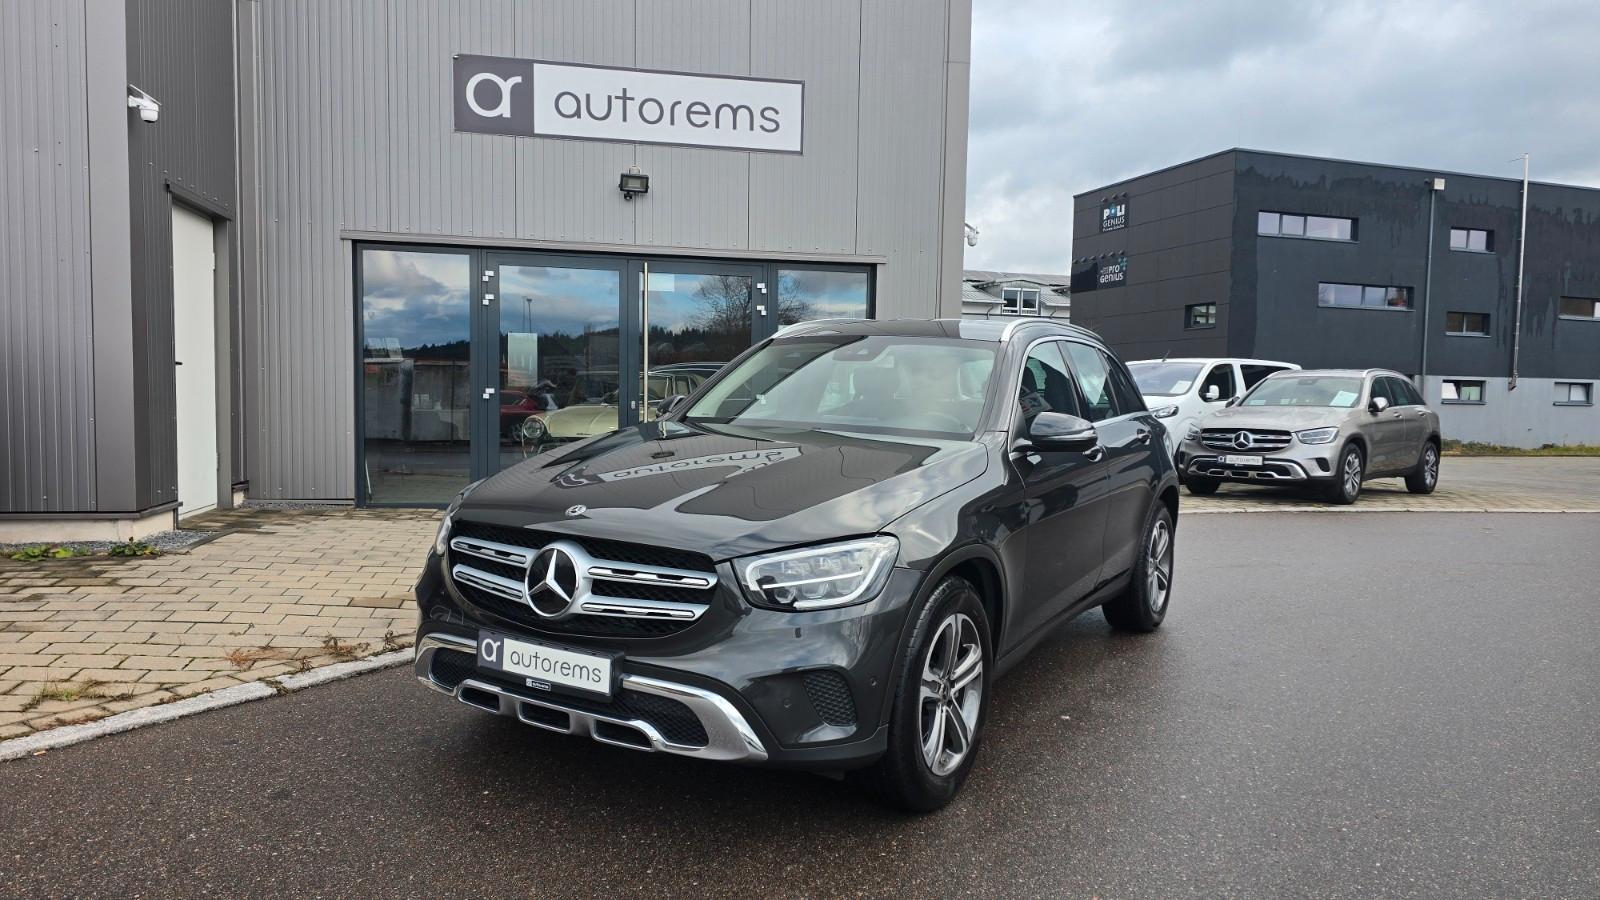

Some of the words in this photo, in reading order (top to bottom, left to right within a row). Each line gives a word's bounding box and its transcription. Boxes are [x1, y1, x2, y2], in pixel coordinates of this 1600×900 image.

[554, 88, 780, 133] autorems
[1103, 216, 1125, 228] GENIUS
[510, 651, 602, 683] autorems
